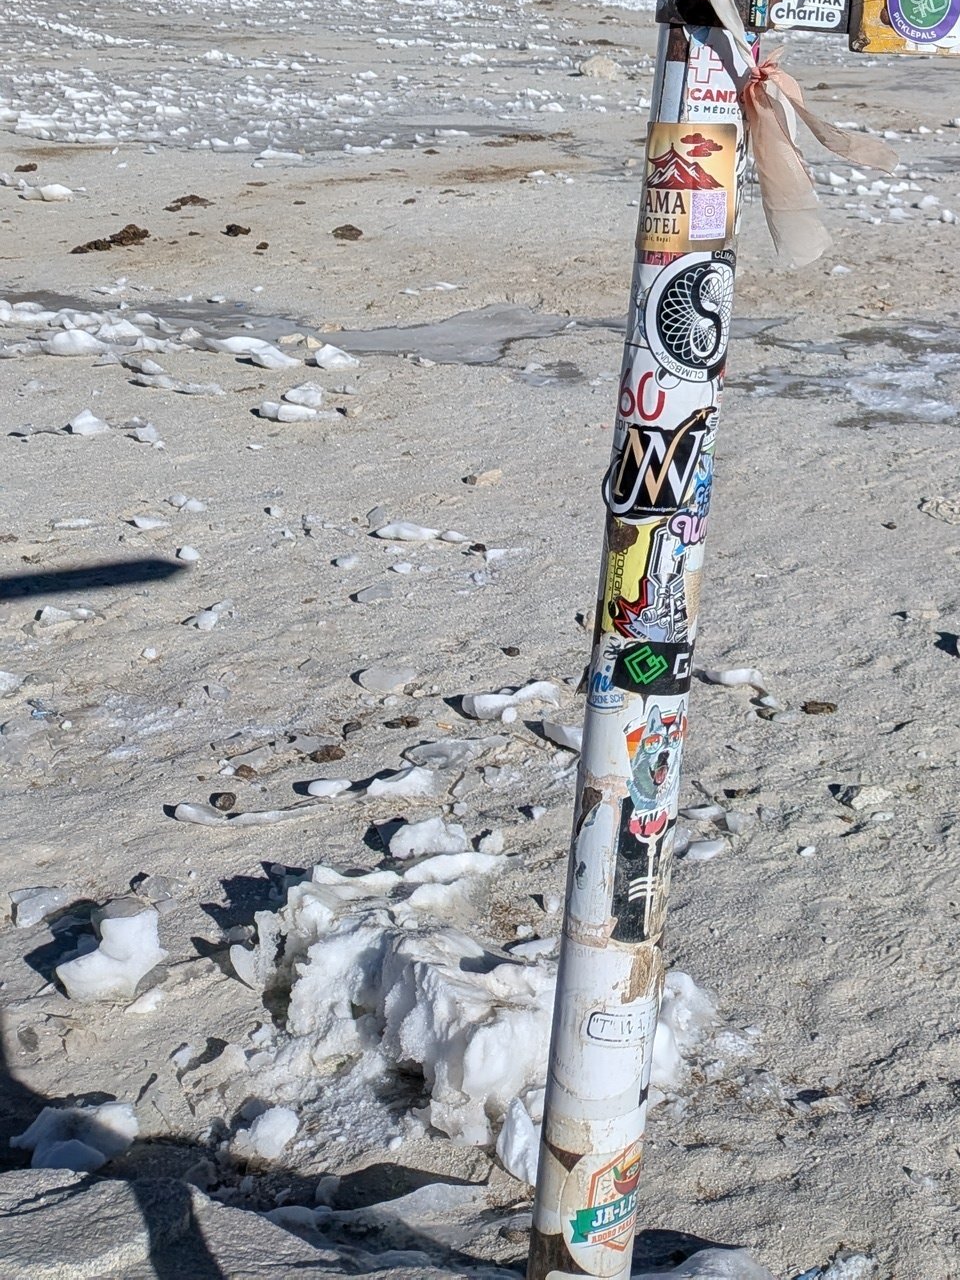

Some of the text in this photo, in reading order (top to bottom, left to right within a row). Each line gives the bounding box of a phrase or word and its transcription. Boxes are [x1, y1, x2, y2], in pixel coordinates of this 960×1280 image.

[775, 2, 836, 23] charlie
[892, 11, 937, 40] PICKLEPALS
[640, 189, 687, 215] AMA
